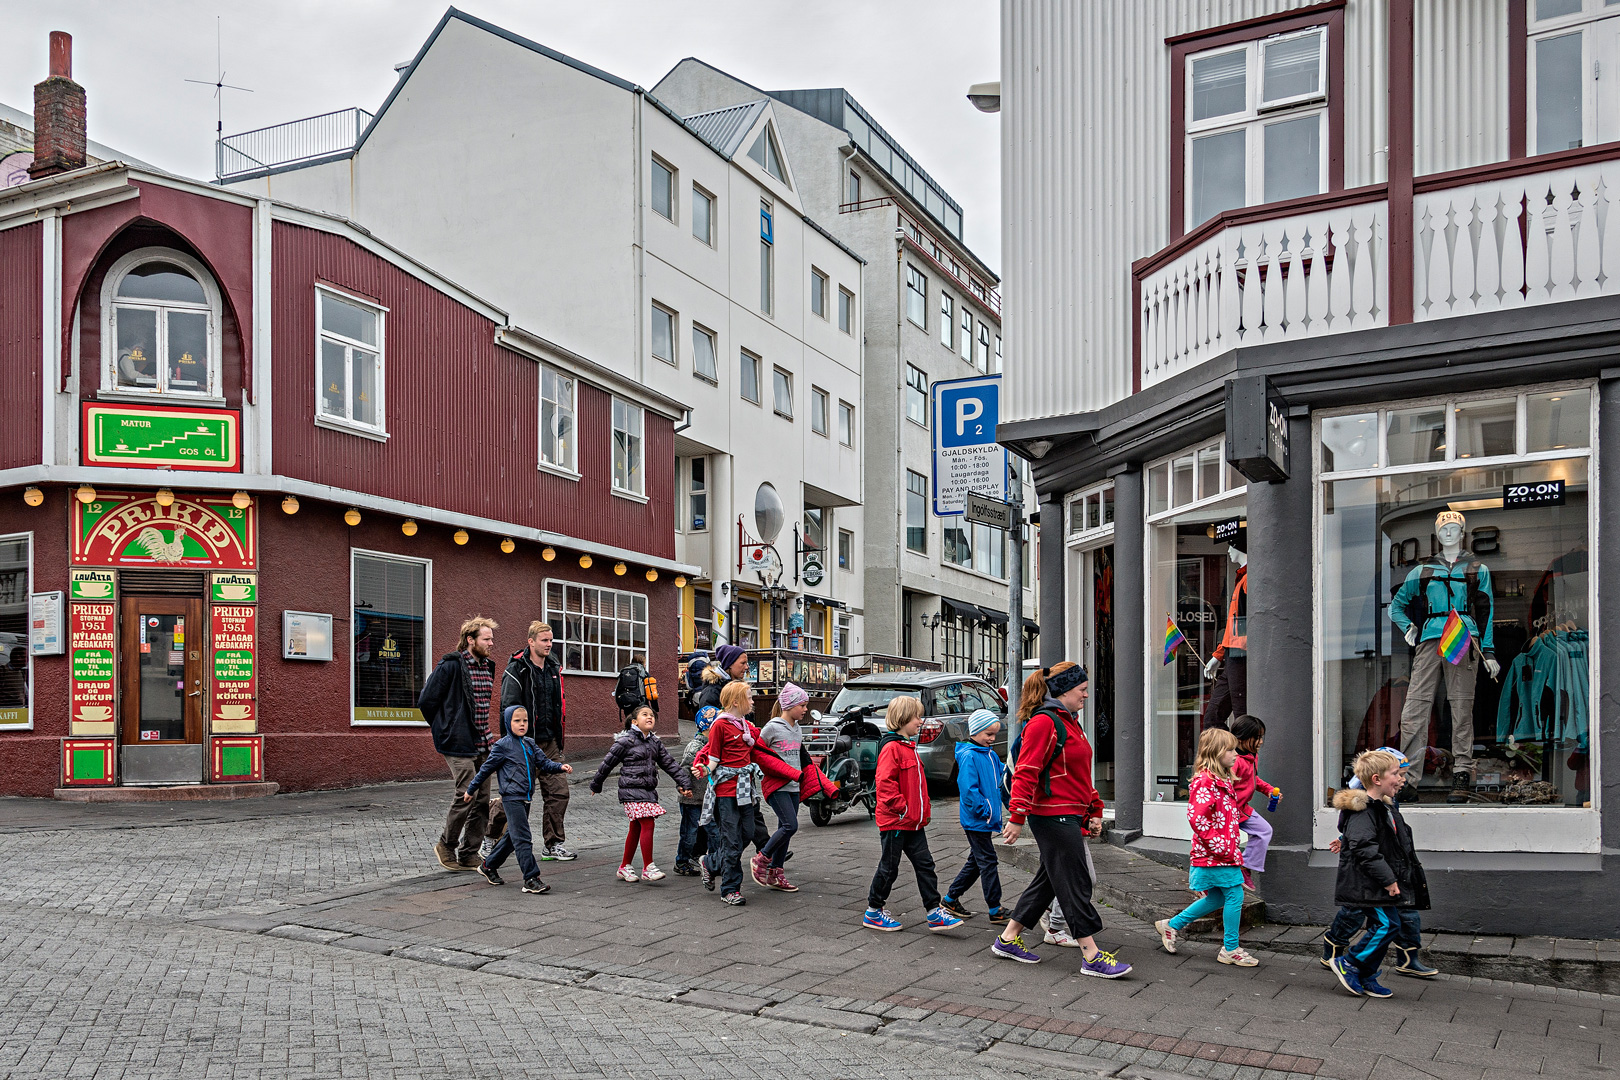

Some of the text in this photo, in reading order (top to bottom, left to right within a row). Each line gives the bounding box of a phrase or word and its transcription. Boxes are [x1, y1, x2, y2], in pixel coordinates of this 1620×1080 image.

[956, 397, 984, 436] P 2
[121, 420, 152, 428] MATUR
[179, 447, 217, 456] GOS ÖL
[941, 446, 999, 457] GJALDSKYLDA
[950, 470, 990, 478] Laugardaga
[1507, 494, 1560, 503] ICELAND
[86, 503, 103, 514] 12
[971, 500, 1007, 522] Ingólfsstræti
[228, 509, 244, 519] 12
[98, 502, 231, 548] PRIKIÐ
[74, 571, 112, 581] LAVAZZA
[216, 575, 252, 585] LAVAZZA
[73, 604, 113, 616] PRIKIÐ
[213, 606, 254, 618] PRIKIÐ
[80, 622, 106, 631] 1951
[222, 623, 246, 632] 1951
[73, 631, 113, 641] NÝLAGAÐ
[215, 633, 253, 642] NÝLAGAÐ
[72, 640, 114, 649] GÆÐAKAFFI
[215, 641, 253, 649] GÆÐAKAFFI
[216, 669, 251, 677] KVÖLDS
[74, 693, 113, 701] KÖKUR
[216, 692, 252, 700] KÖKUR
